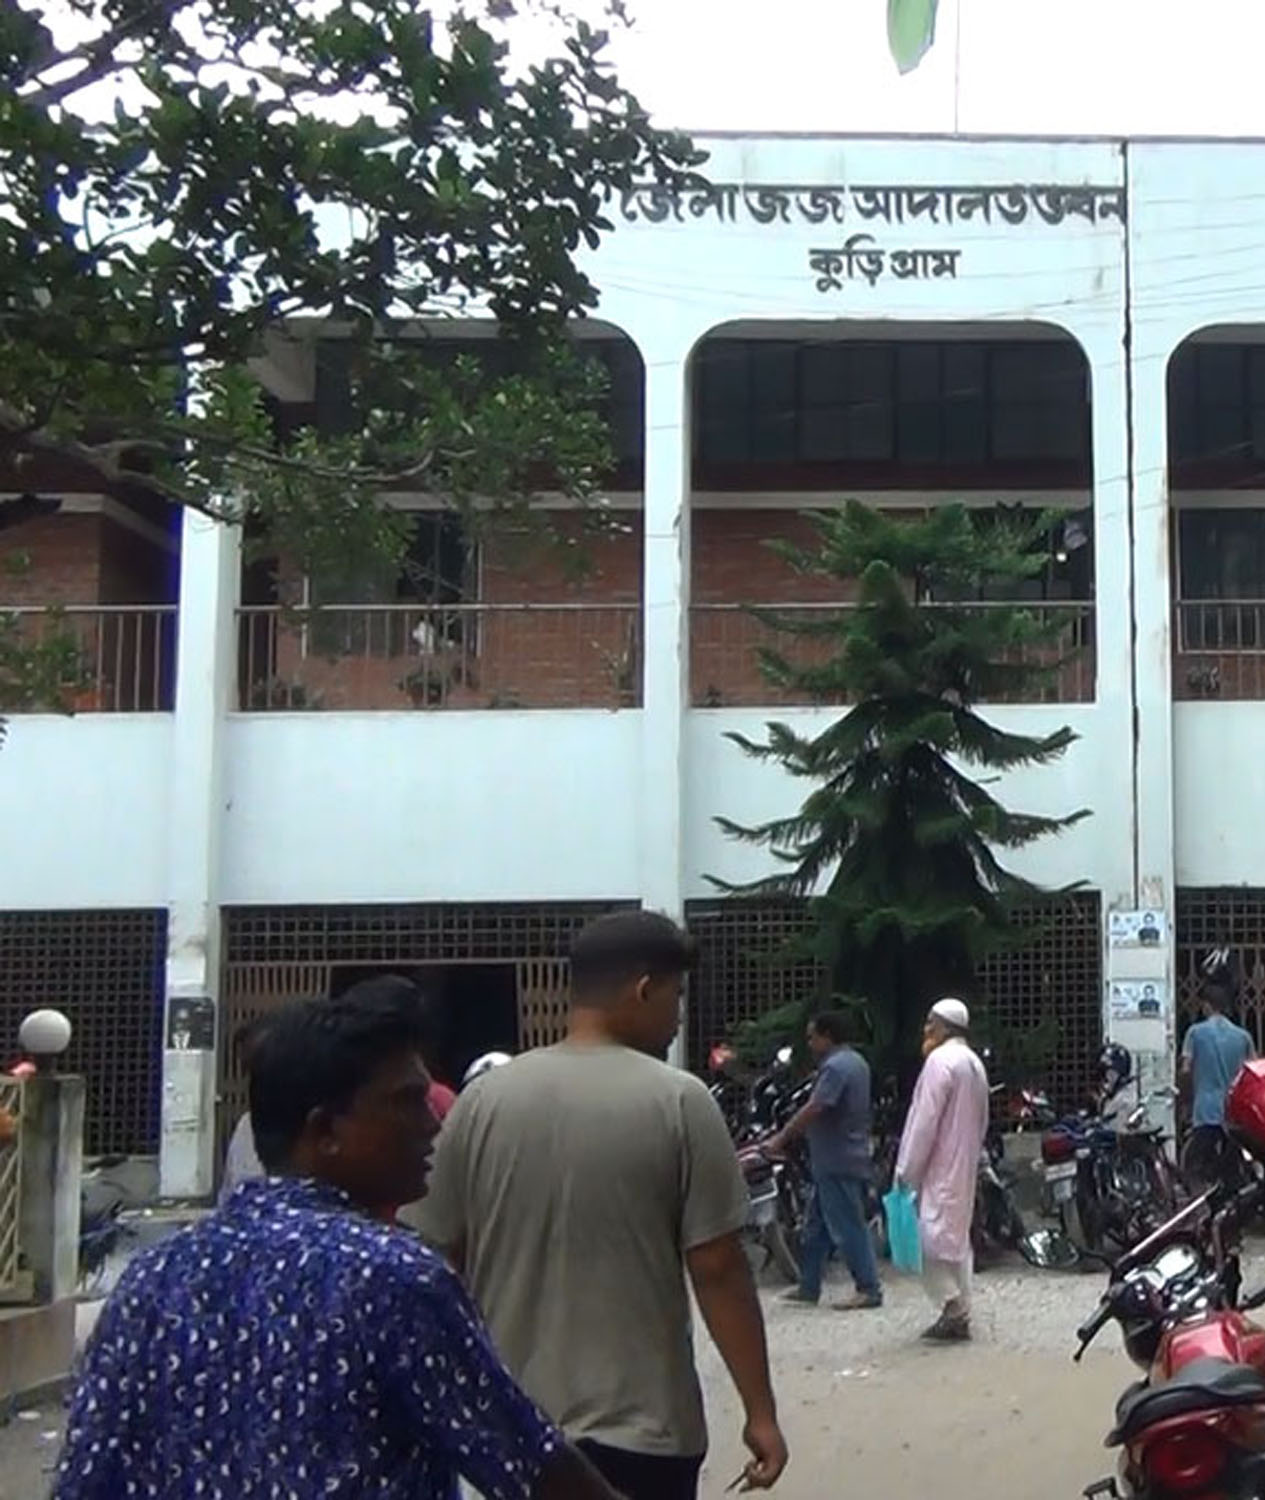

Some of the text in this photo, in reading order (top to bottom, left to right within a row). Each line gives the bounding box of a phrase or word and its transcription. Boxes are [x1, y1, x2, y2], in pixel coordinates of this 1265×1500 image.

[621, 183, 1127, 225] জেলা জজ আদালত ভবন
